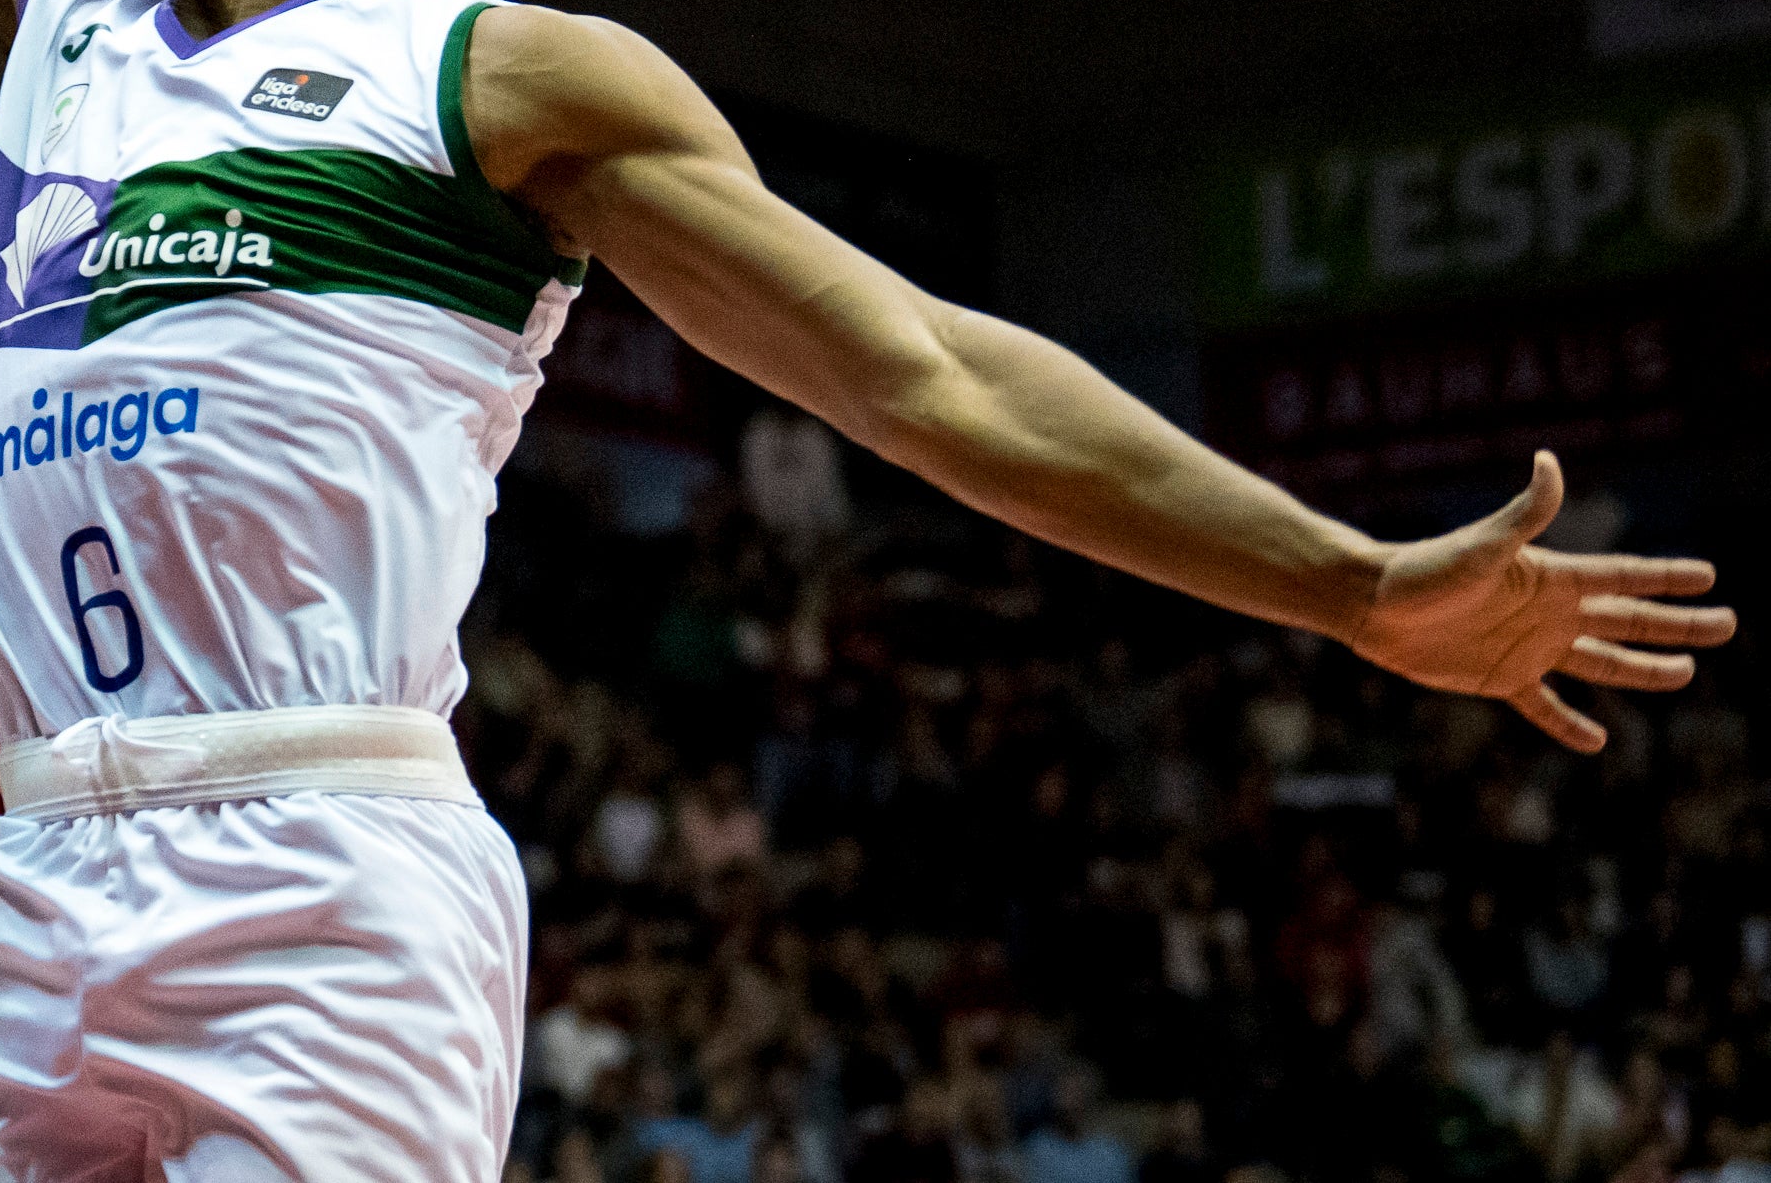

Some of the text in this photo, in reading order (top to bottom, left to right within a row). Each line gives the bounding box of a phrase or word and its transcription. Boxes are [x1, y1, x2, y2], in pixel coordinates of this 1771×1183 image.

[250, 92, 331, 118] endesa
[259, 77, 300, 95] liga
[1256, 102, 1771, 295] L'ESPO
[78, 208, 274, 278] Unicaja
[59, 525, 146, 694] 6
